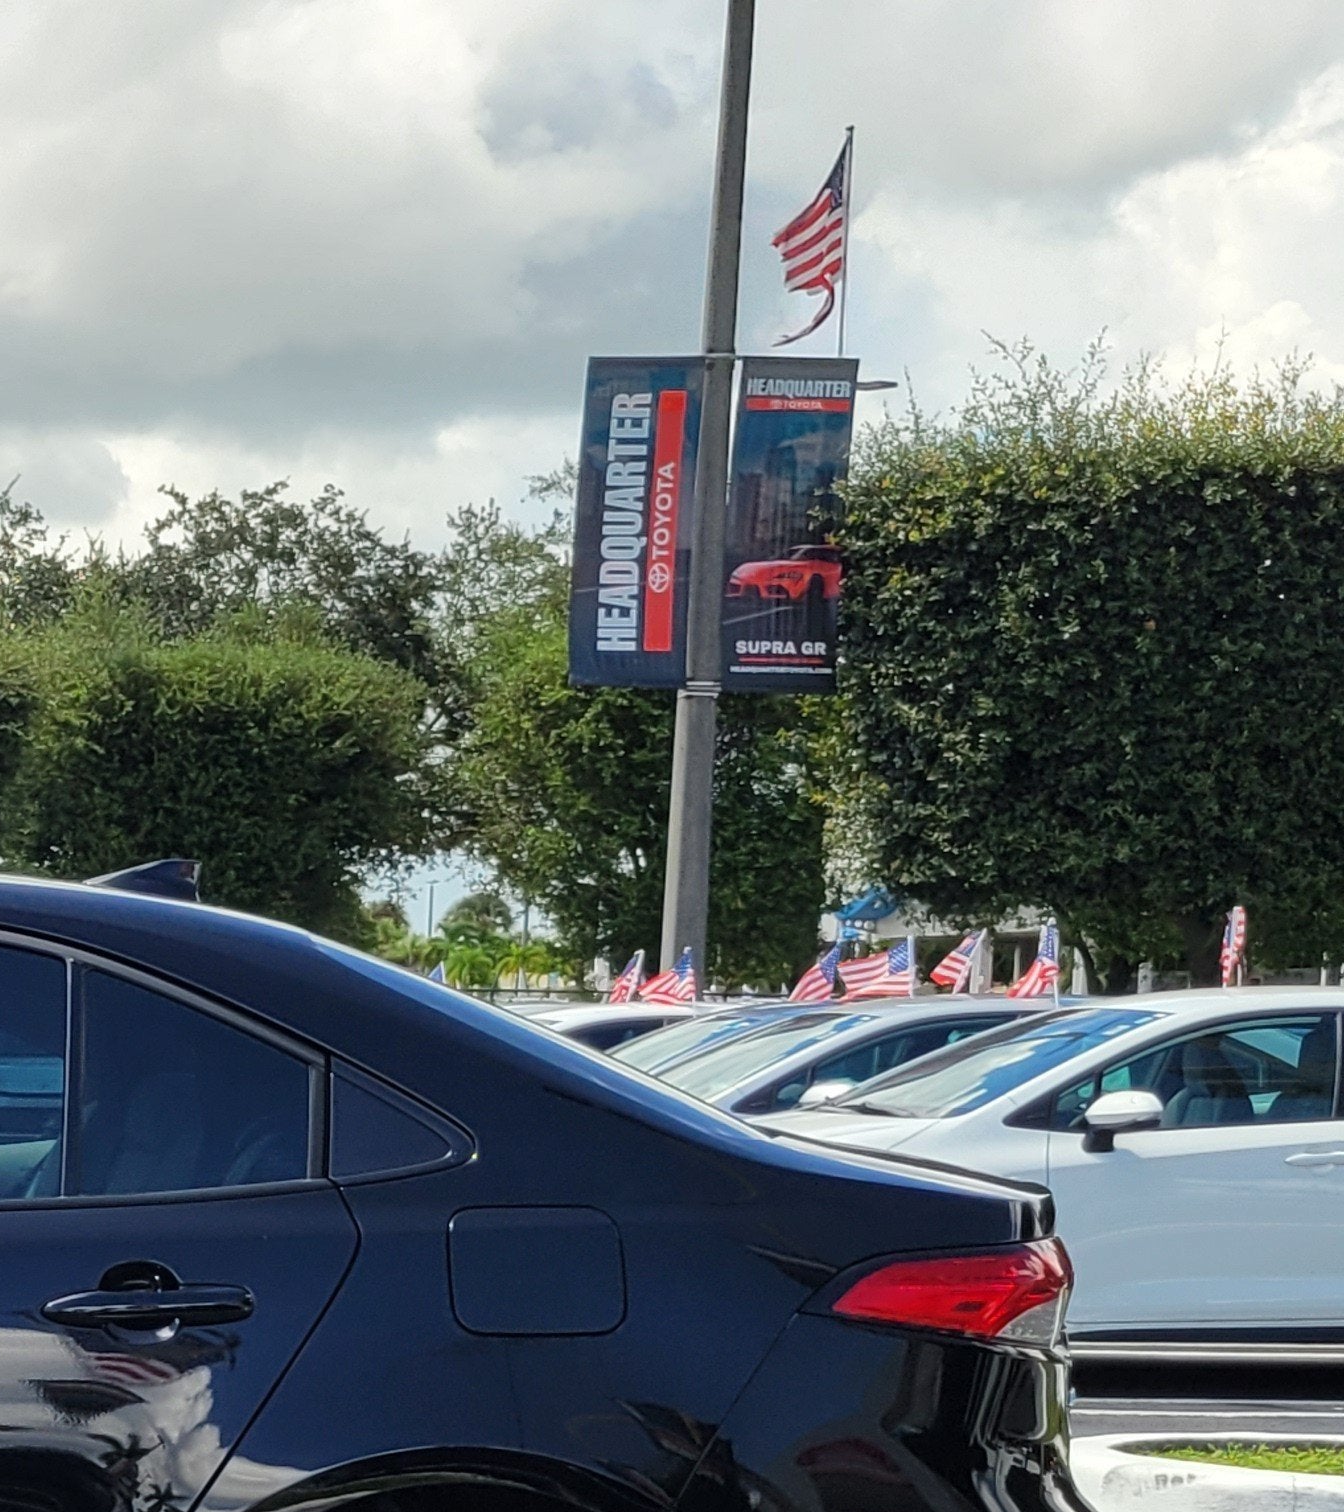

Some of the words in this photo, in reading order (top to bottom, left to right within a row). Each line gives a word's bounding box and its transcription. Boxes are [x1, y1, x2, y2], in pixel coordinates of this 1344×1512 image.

[746, 378, 851, 398] HEADQUARTER
[784, 401, 823, 410] TOYOTA
[651, 461, 676, 561] TOYOTA
[596, 392, 653, 652] HEADQUARTER
[735, 640, 797, 655] SUPRA
[800, 641, 827, 656] GR
